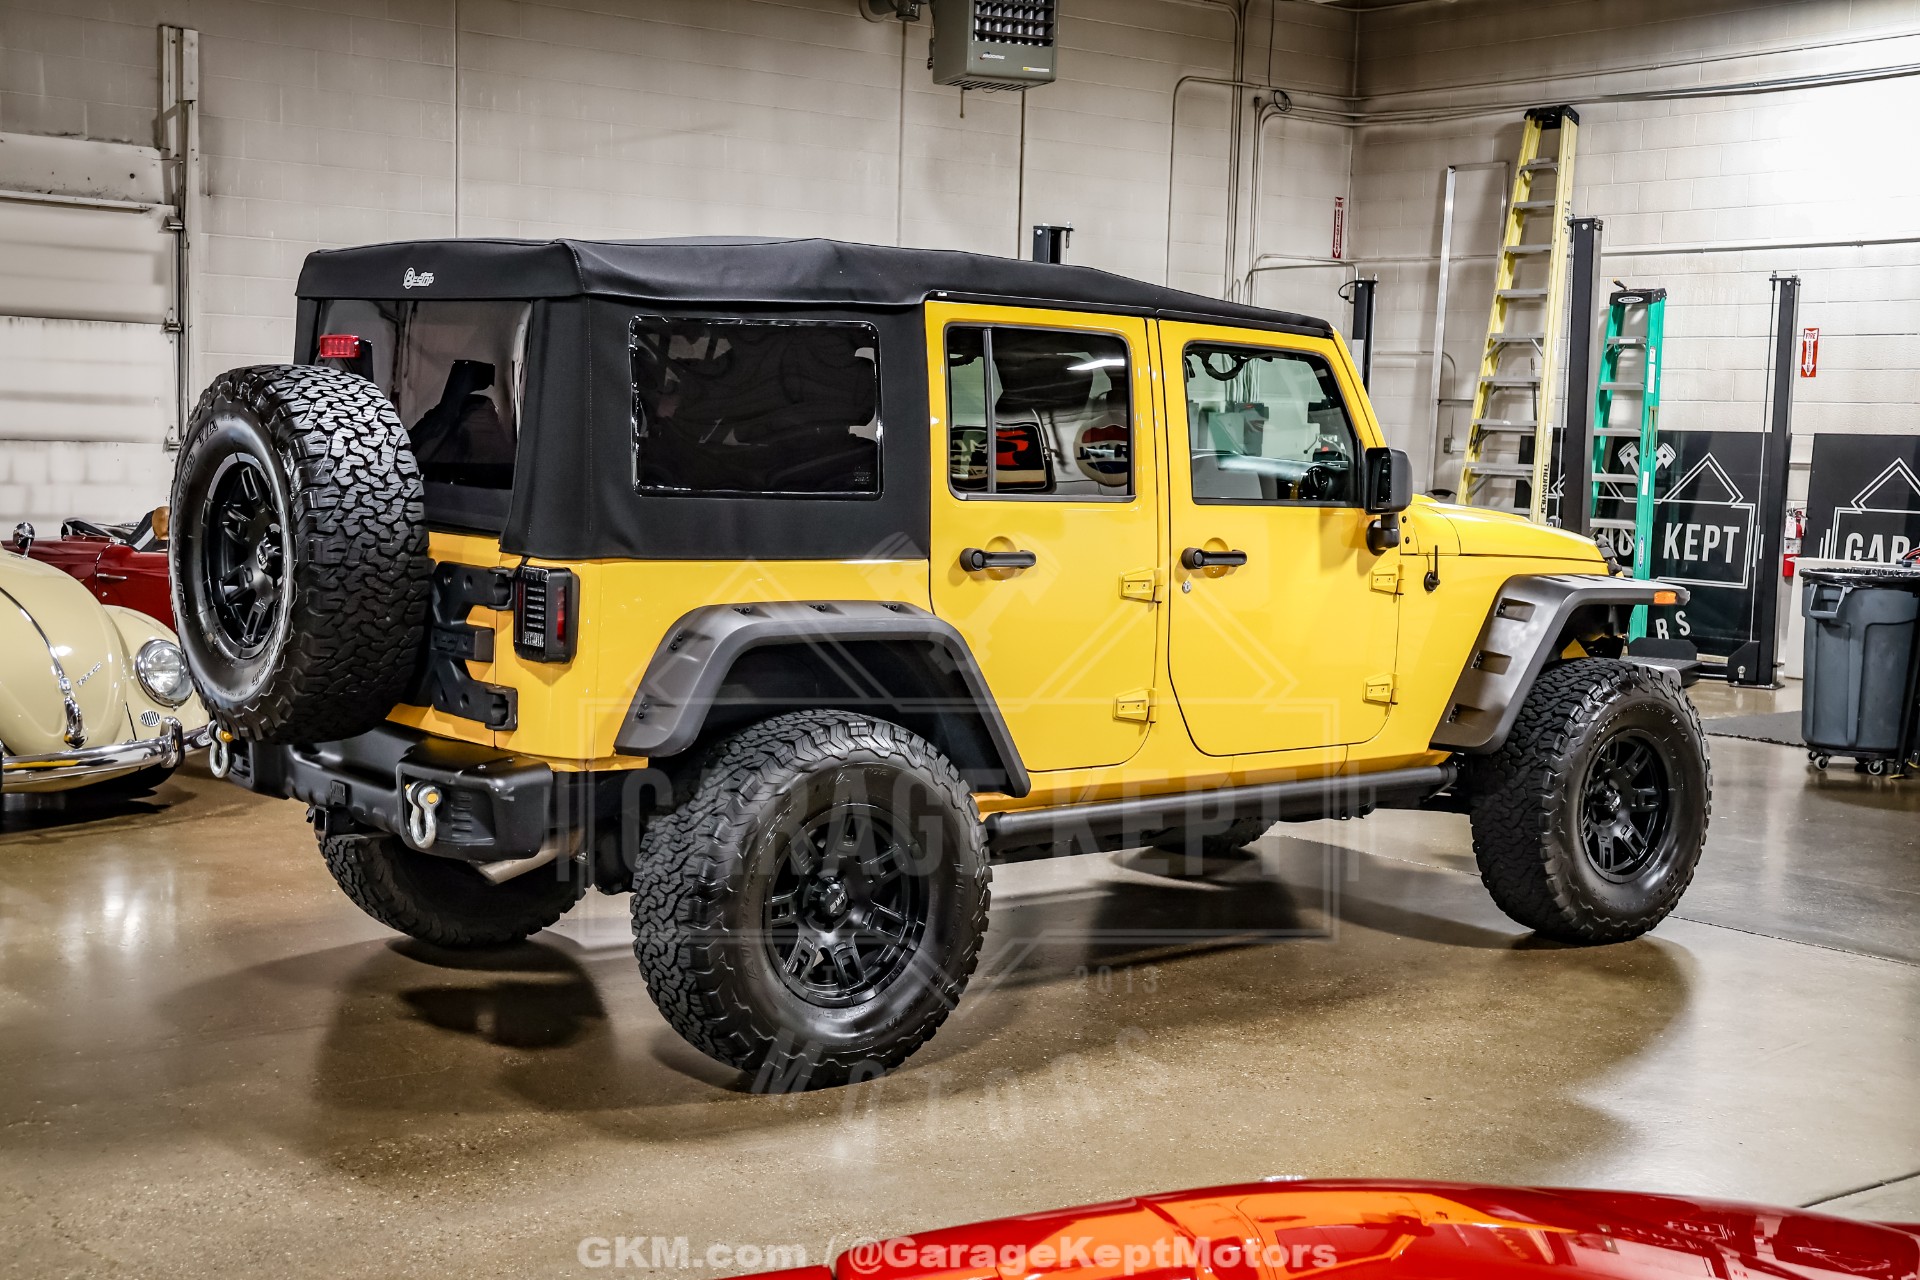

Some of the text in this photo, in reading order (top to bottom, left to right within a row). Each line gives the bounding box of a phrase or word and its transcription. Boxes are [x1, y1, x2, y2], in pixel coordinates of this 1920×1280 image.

[1805, 332, 1817, 340] FIRE
[1662, 522, 1741, 564] KEPT
[1844, 532, 1920, 565] GAR
